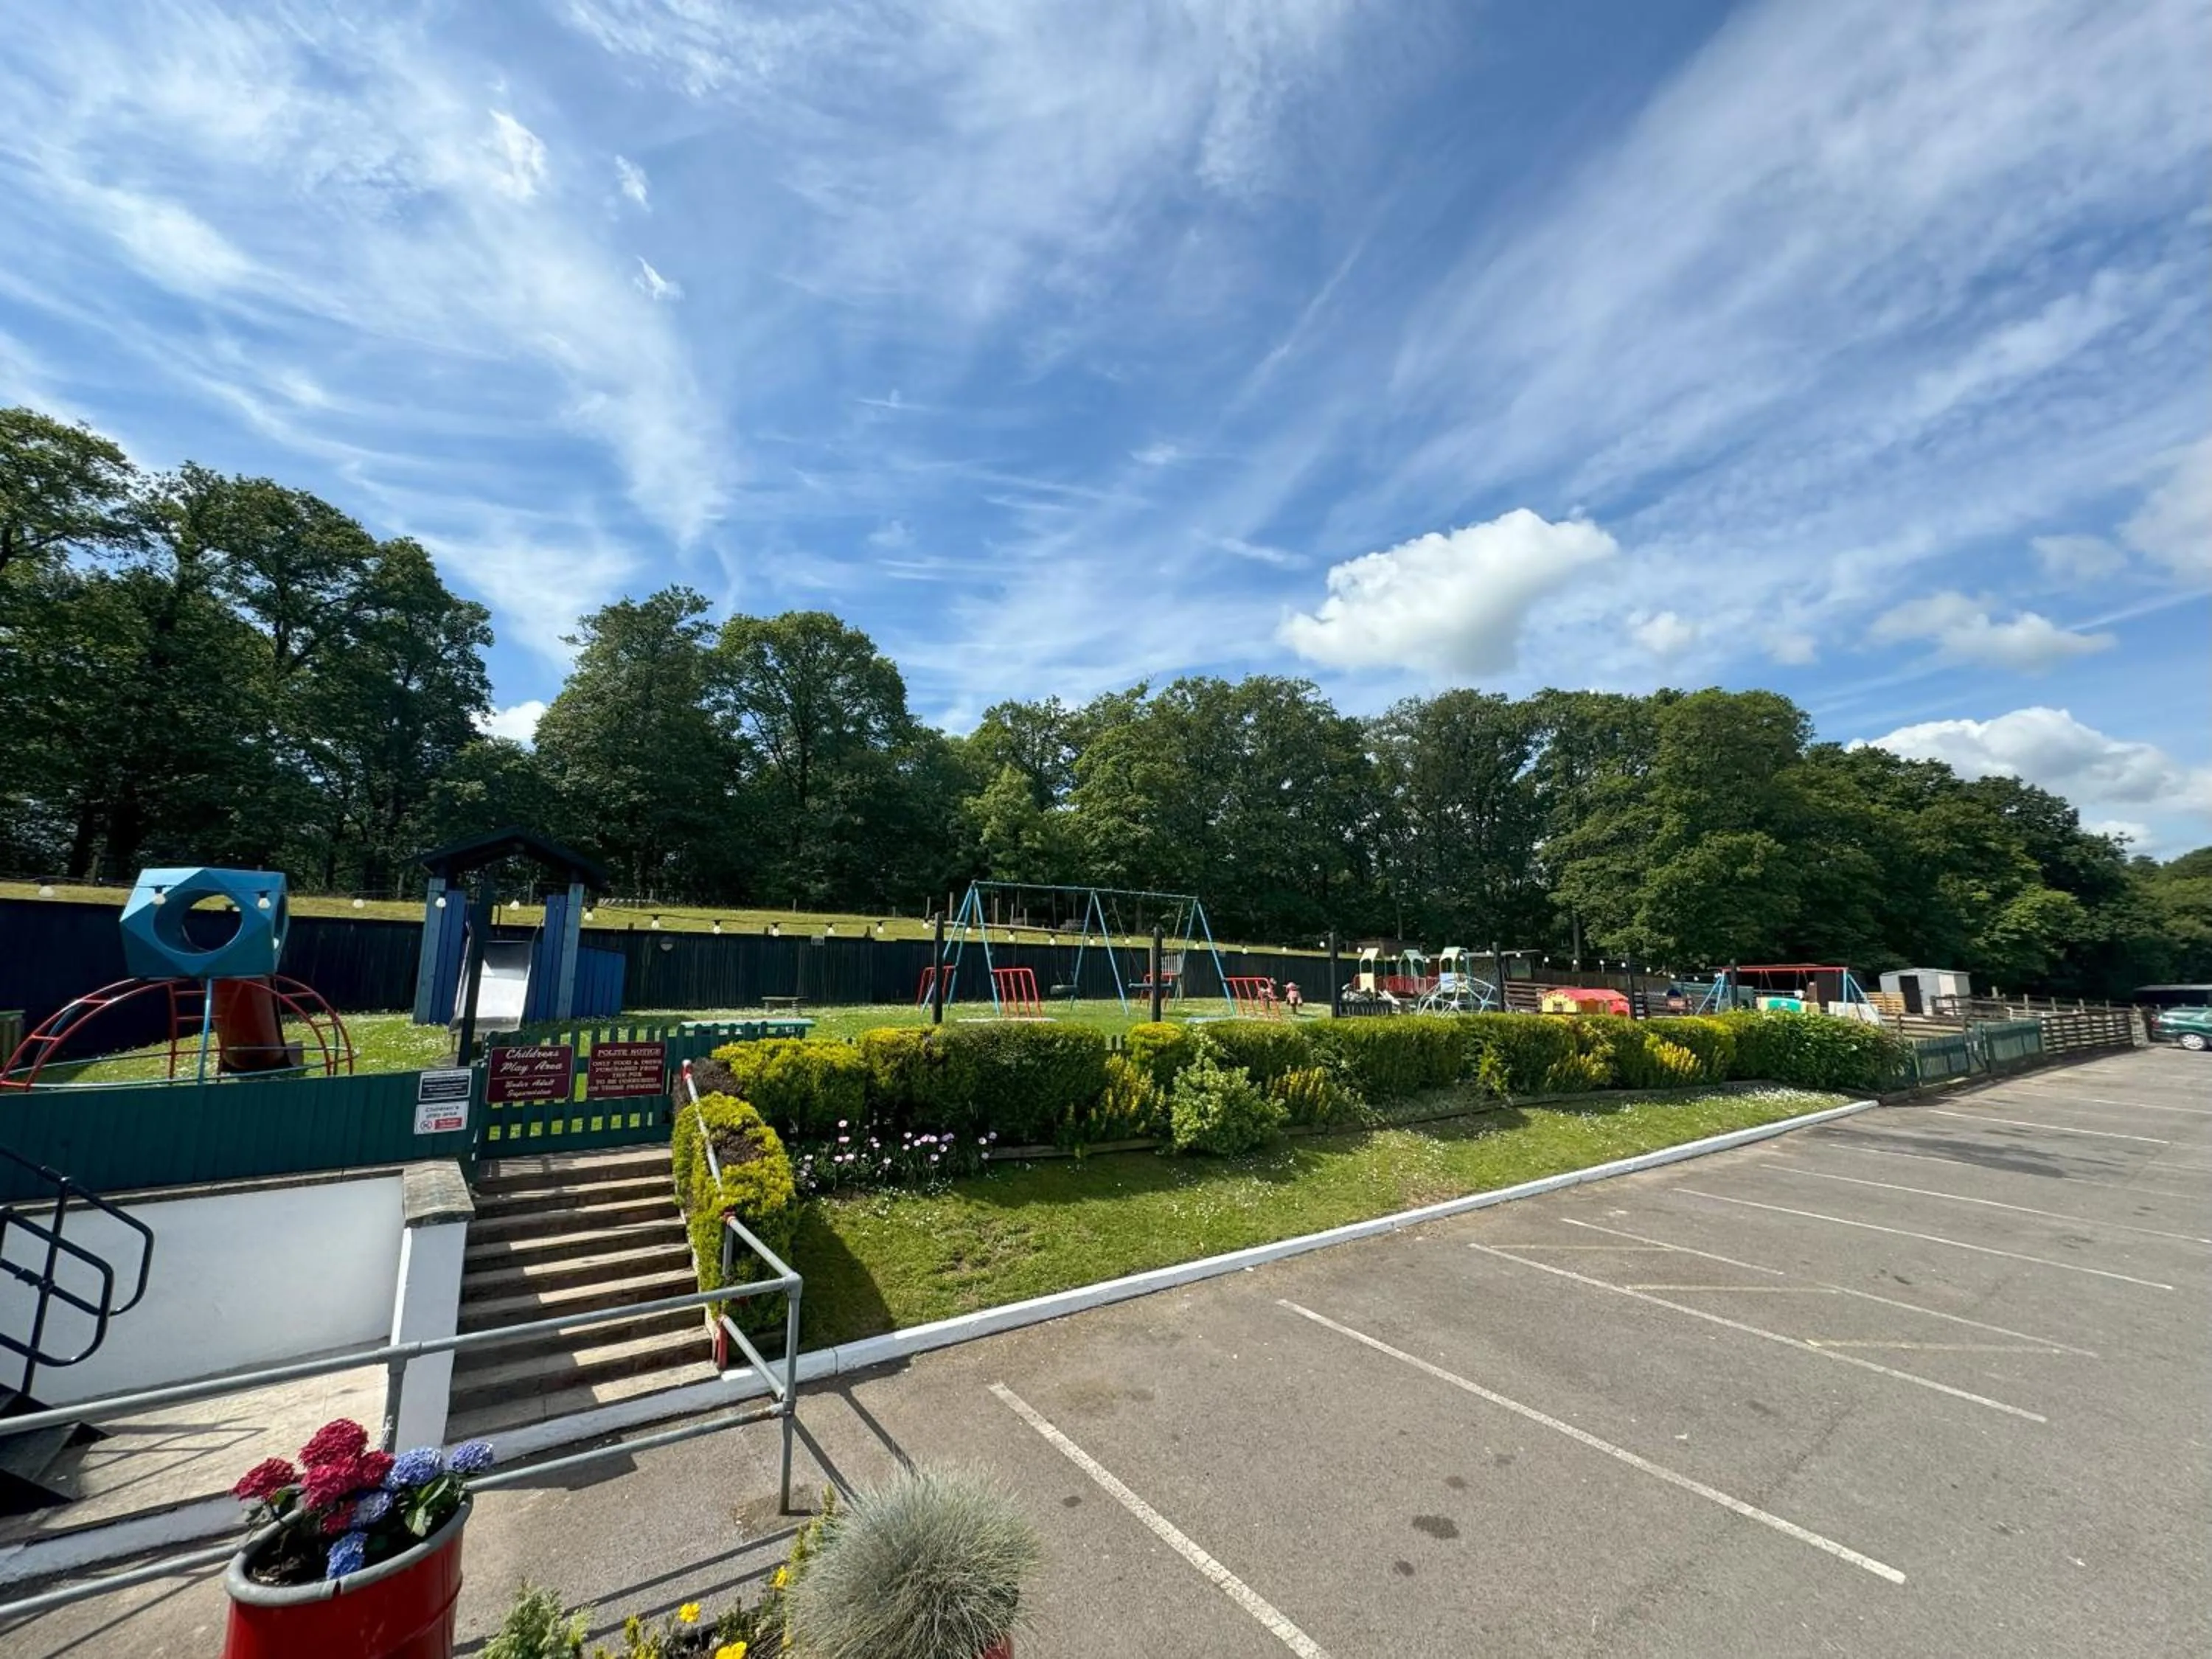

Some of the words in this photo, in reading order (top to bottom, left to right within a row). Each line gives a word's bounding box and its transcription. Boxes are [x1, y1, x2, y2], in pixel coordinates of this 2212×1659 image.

[505, 1048, 559, 1059] Childrens
[630, 1048, 661, 1056] NOTICE
[500, 1061, 529, 1075] Play
[534, 1060, 563, 1071] Area
[504, 1080, 529, 1088] Under
[507, 1089, 552, 1097] Supervision
